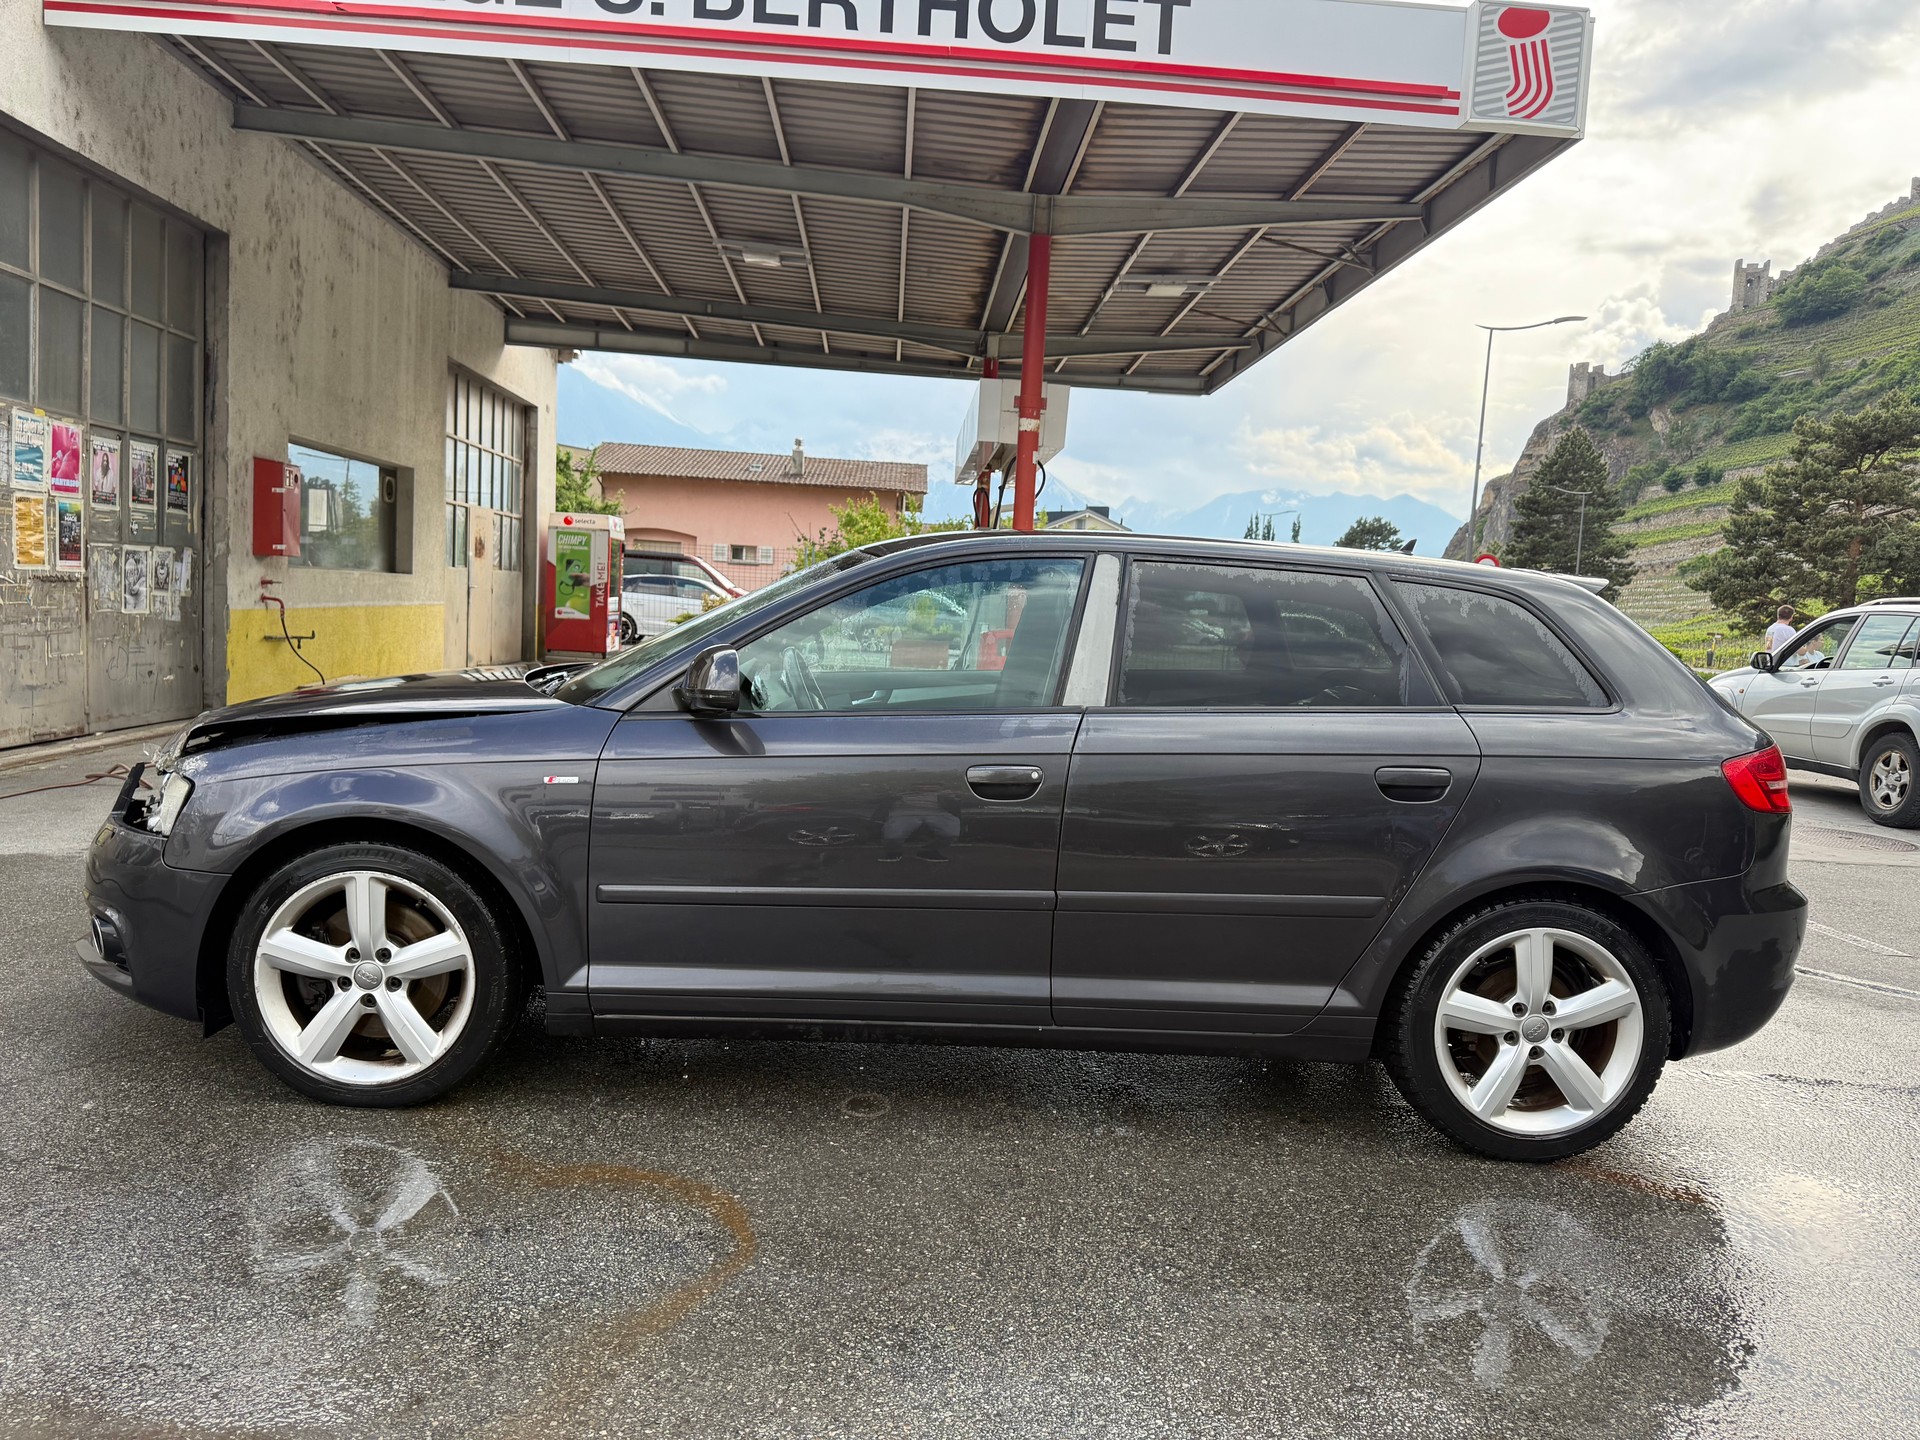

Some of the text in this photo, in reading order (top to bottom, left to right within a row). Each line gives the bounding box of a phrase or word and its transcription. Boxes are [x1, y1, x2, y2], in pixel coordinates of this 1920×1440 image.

[558, 534, 588, 545] CHIMPY
[595, 562, 606, 608] TAKE ME!
